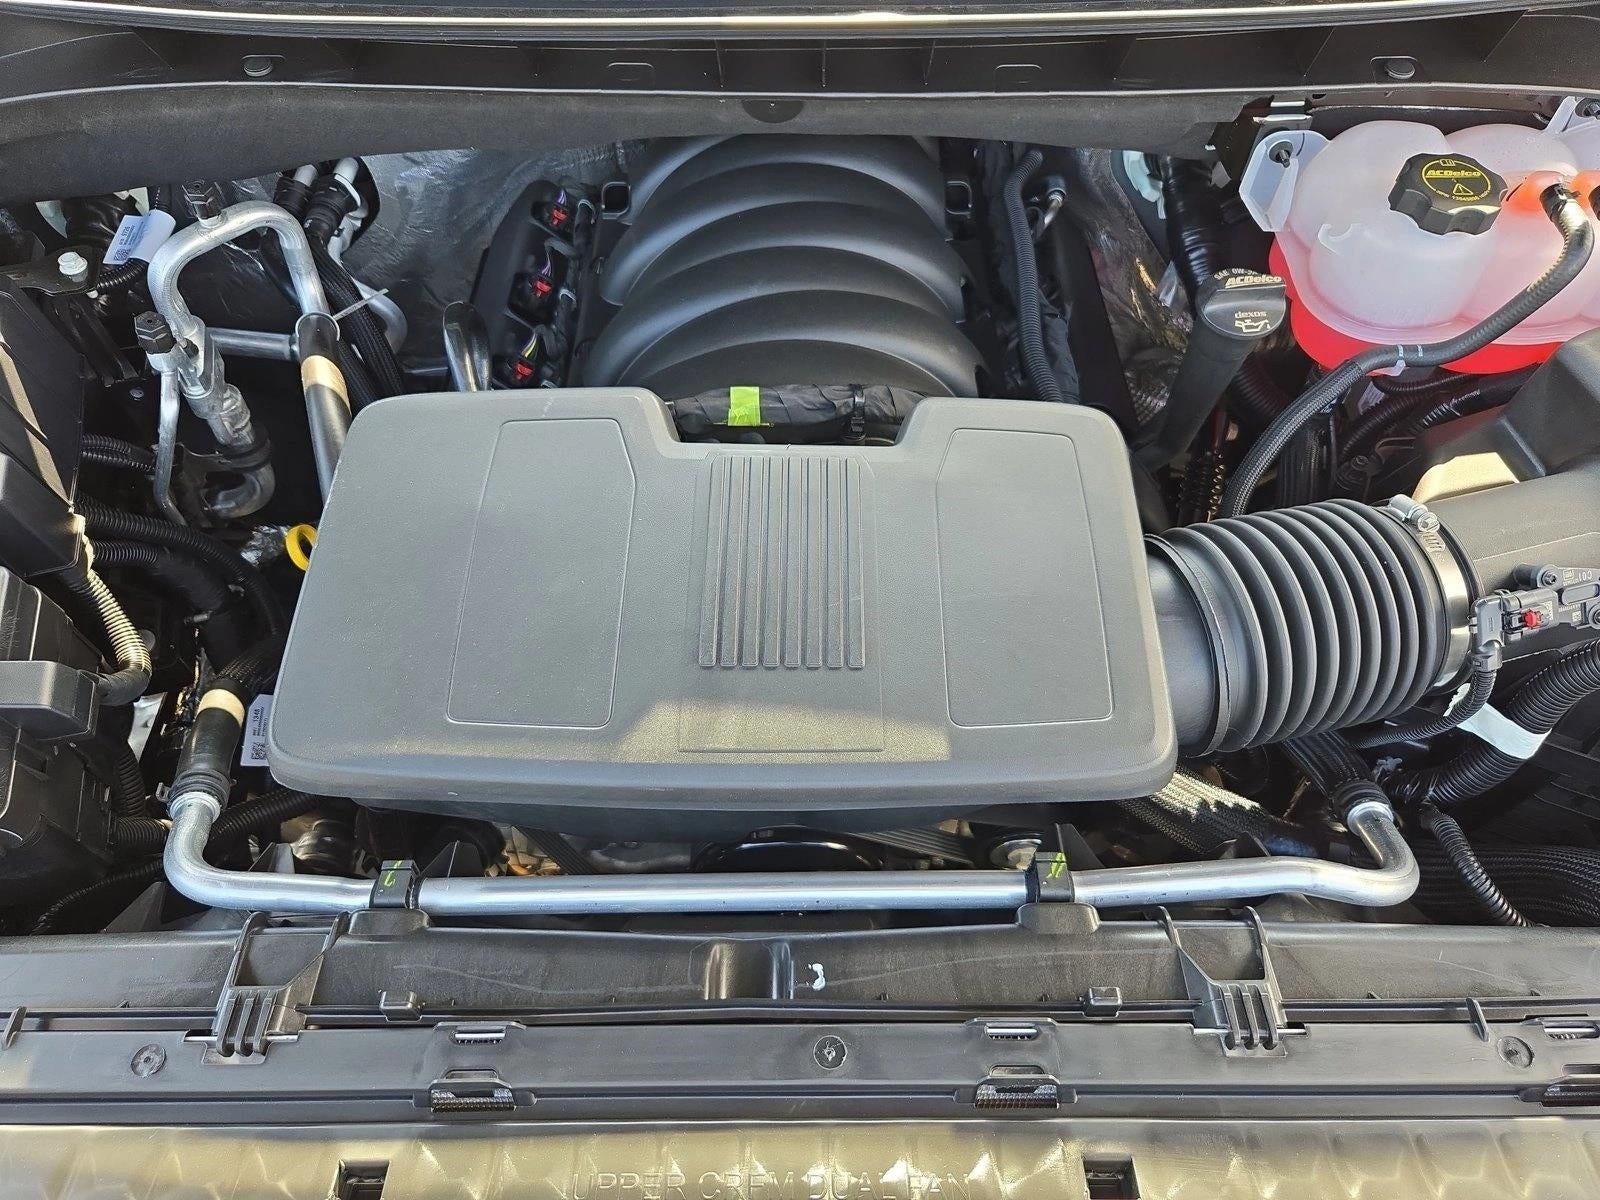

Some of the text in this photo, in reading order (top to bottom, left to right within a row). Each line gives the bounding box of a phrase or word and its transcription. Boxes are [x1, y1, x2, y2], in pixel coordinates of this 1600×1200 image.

[1426, 169, 1482, 178] ACDelco
[1214, 269, 1230, 280] SAE
[1226, 274, 1282, 287] ACDelco
[1235, 311, 1267, 319] dexos
[571, 1171, 687, 1200] UPPER
[807, 1172, 897, 1200] DUAL
[907, 1173, 971, 1200] FAN
